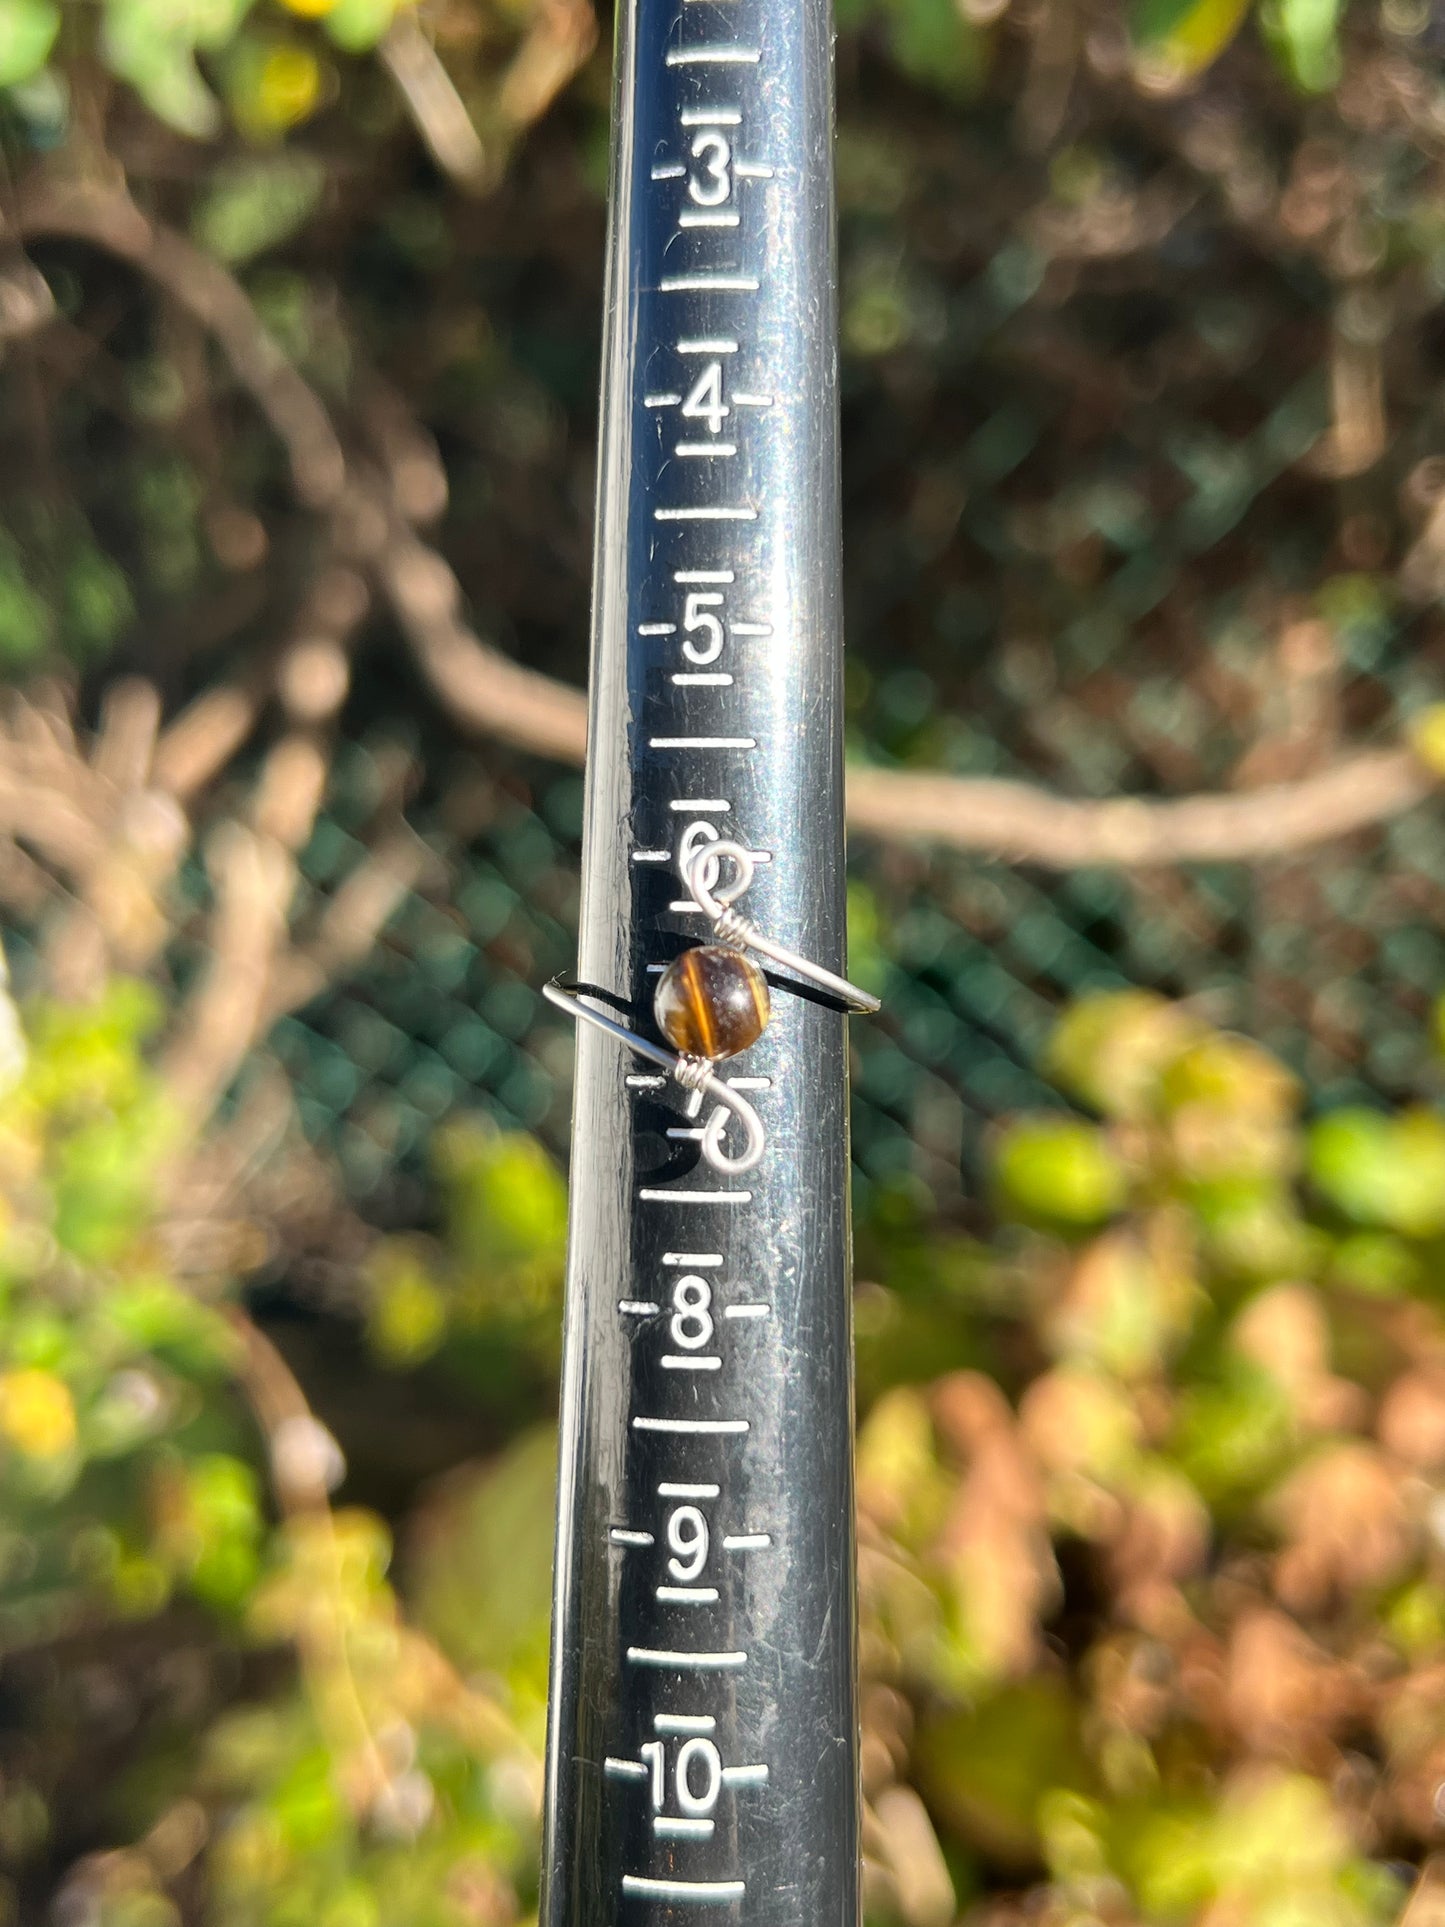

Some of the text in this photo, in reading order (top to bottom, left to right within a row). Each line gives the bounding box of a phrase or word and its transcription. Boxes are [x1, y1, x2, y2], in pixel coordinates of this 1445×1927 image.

[688, 131, 731, 206] 3
[682, 361, 730, 434] 4
[682, 593, 725, 665] 5
[679, 820, 720, 893] 6
[671, 1274, 714, 1349] 8
[667, 1505, 709, 1580] 9
[641, 1737, 722, 1814] 10
